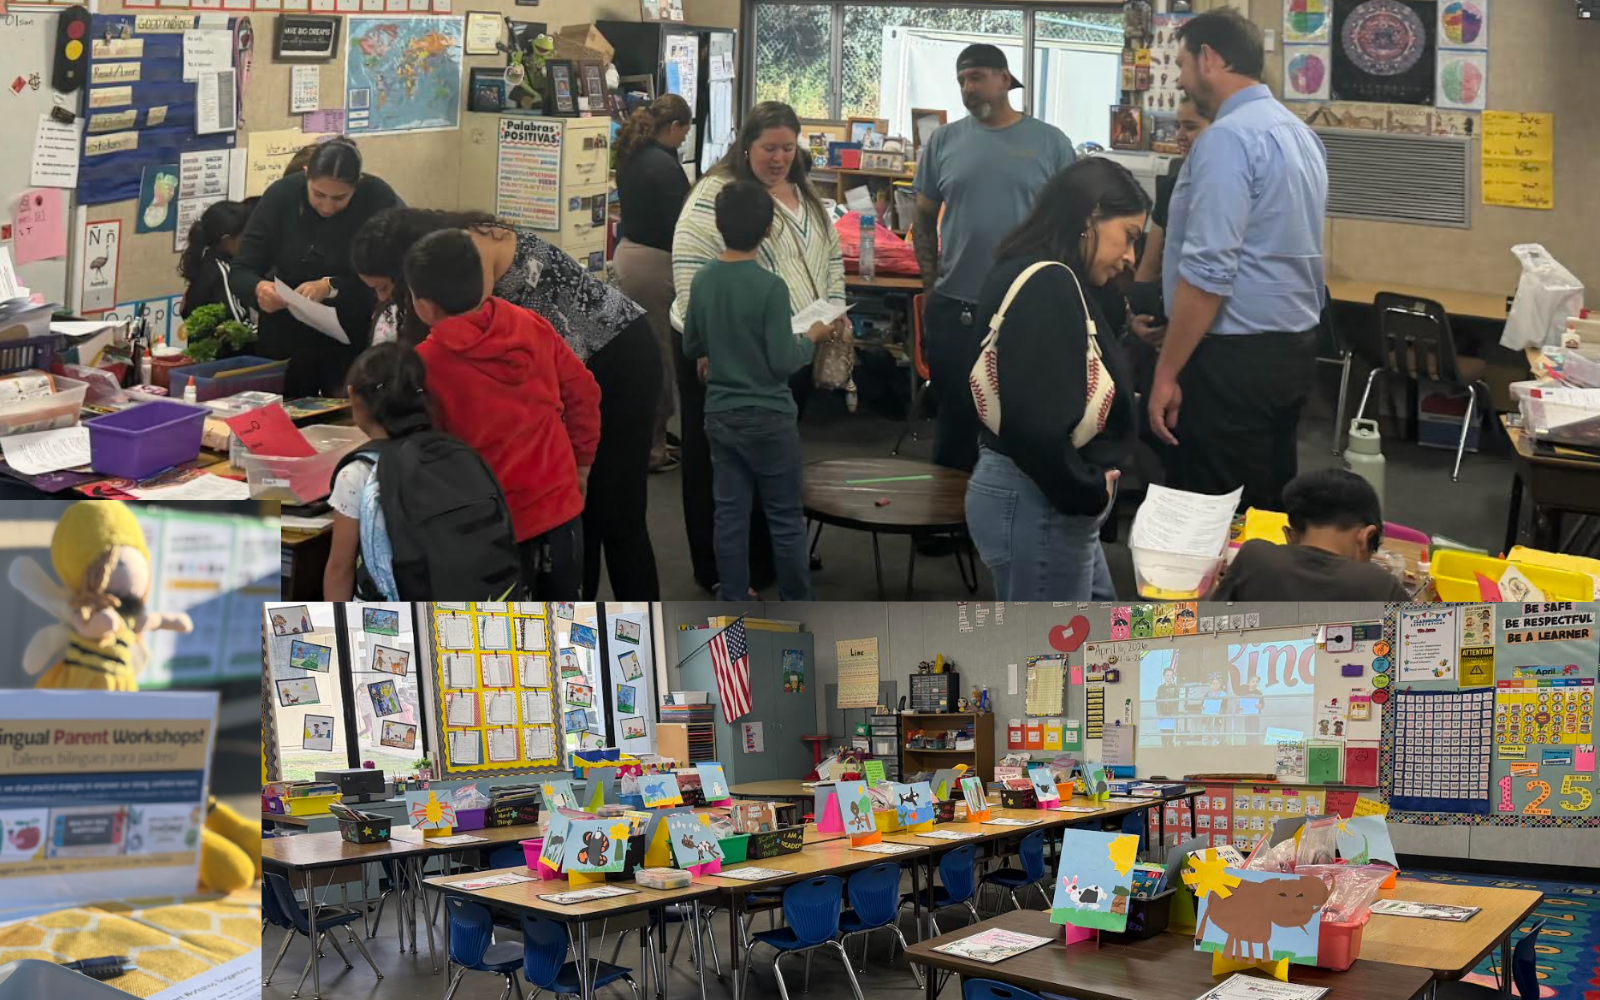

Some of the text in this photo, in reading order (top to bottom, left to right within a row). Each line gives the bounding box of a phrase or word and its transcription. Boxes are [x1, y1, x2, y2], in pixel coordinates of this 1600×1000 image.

[5, 15, 34, 26] Olson
[138, 18, 192, 30] GOOD CHOICES
[298, 27, 308, 36] BIG
[308, 28, 331, 36] DREAMS
[294, 97, 318, 105] DREAMS
[507, 121, 555, 132] Palabras
[504, 131, 556, 144] POSITIVAS
[89, 226, 115, 245] Ñ ñ
[1525, 602, 1572, 614] BE SAFE
[1505, 614, 1592, 628] BE RESPECTFUL
[1507, 629, 1589, 643] BE A LEARNER
[1094, 643, 1116, 656] April
[1127, 643, 1148, 651] 2026
[1462, 648, 1493, 656] ATTENTION
[1535, 668, 1556, 676] April
[54, 729, 109, 745] Parent
[113, 728, 206, 747] Workshops!
[110, 752, 136, 767] para
[1498, 775, 1592, 815] 1 2 5
[763, 841, 775, 849] Hard
[781, 840, 802, 850] READER
[762, 848, 779, 858] Things
